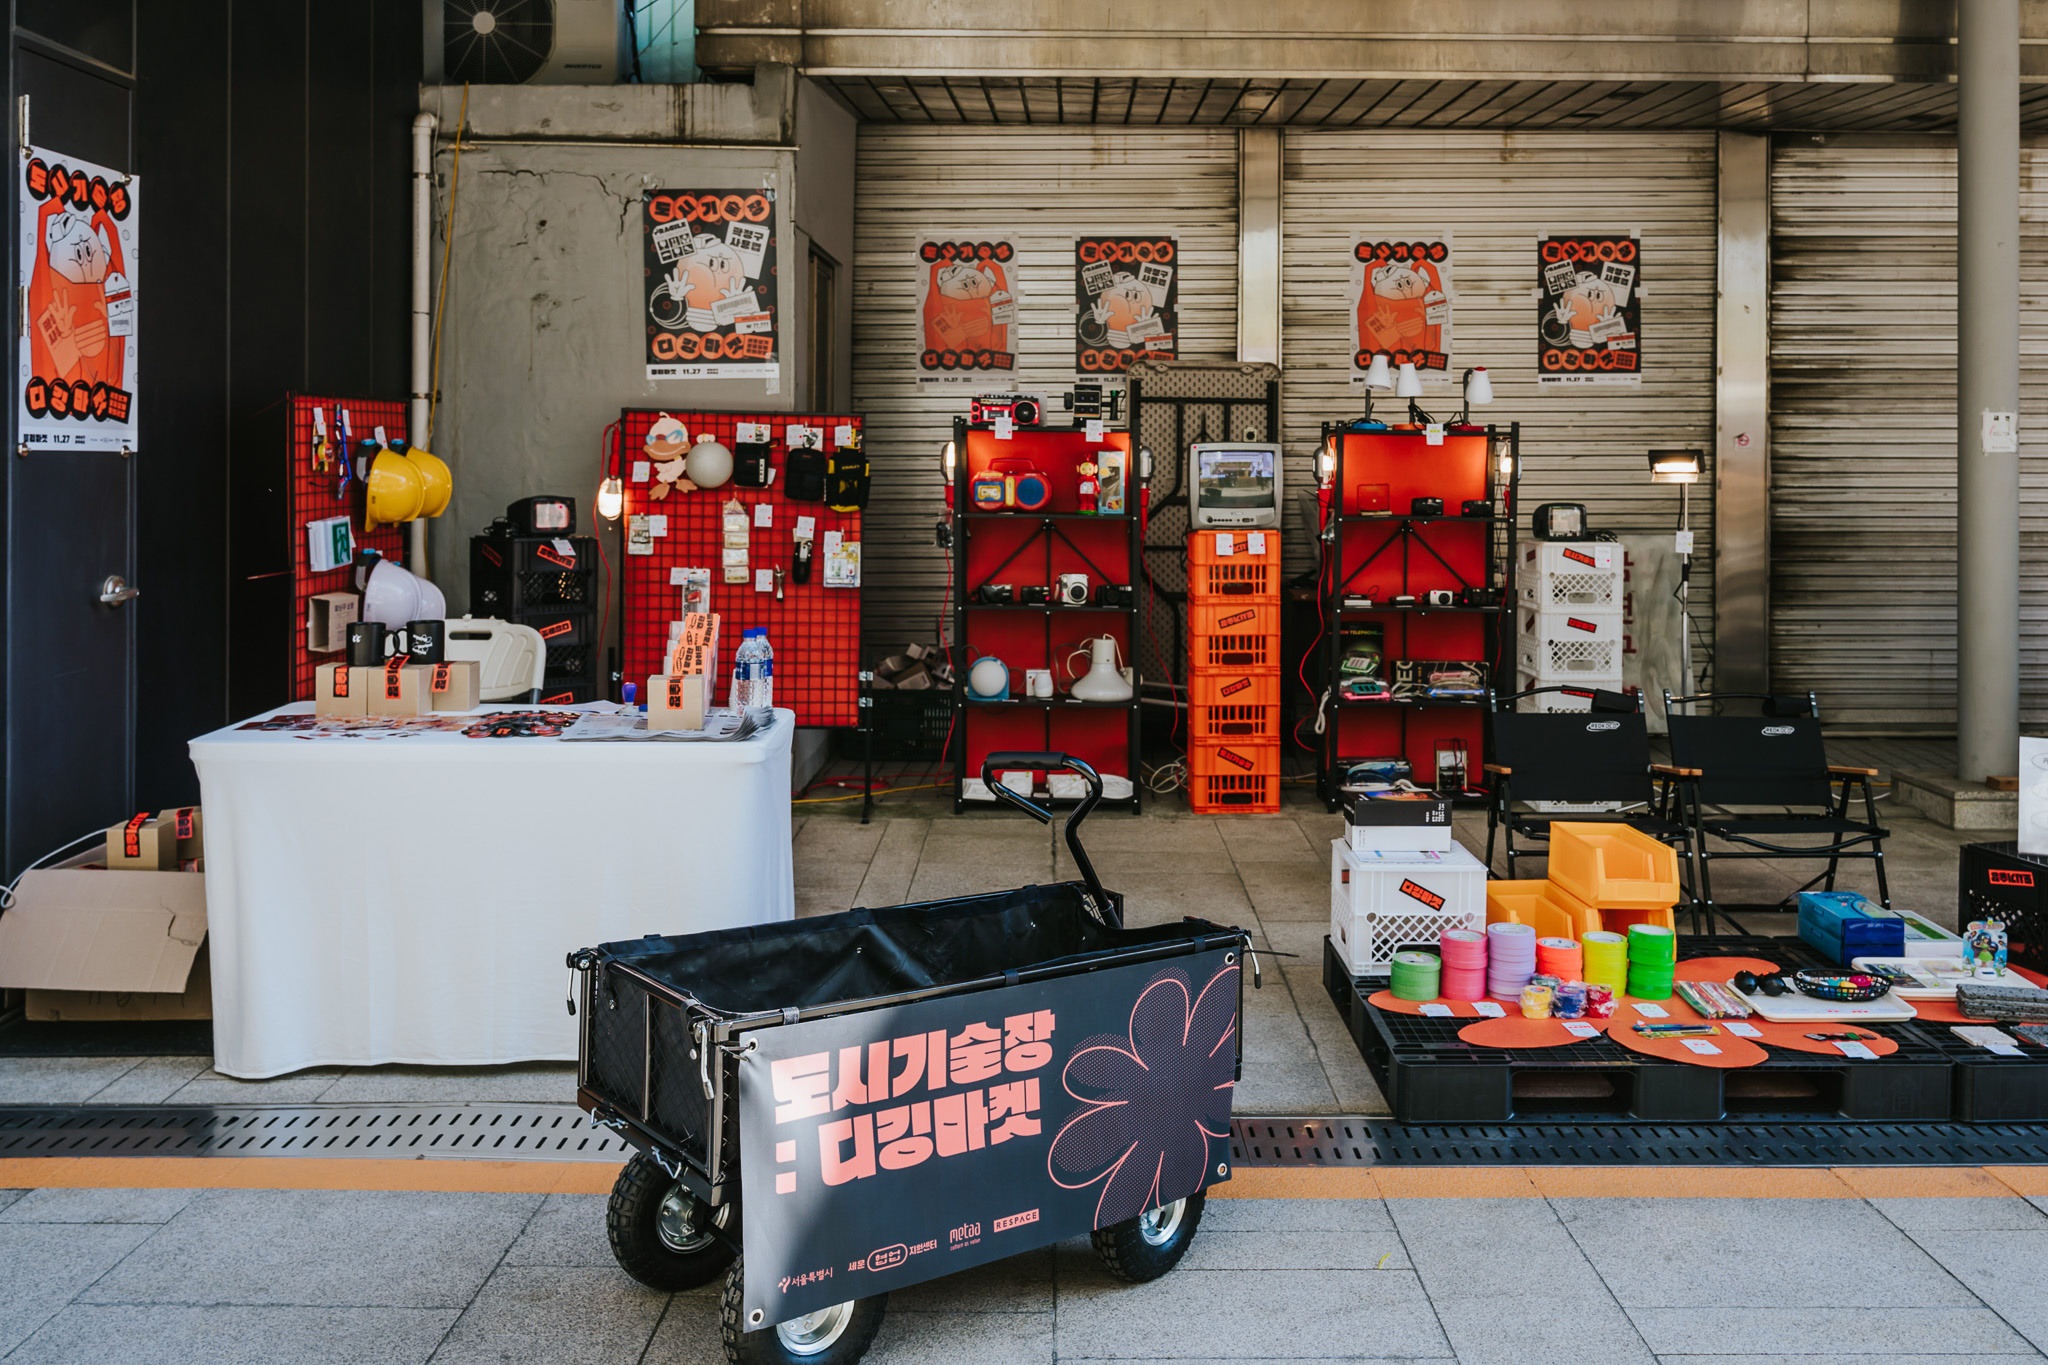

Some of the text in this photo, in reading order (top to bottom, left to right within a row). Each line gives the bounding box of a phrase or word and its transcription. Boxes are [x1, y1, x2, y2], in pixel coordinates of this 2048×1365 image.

[654, 199, 765, 218] 도시기술장
[53, 435, 70, 444] 11.27
[1401, 879, 1445, 910] 디깅마켓
[771, 1009, 1056, 1125] 도시기술장
[818, 1077, 1042, 1187] 디깅마켓
[996, 1211, 1038, 1230] RESPACE
[950, 1221, 981, 1244] metaa
[848, 1239, 938, 1272] 세운 협업 지원센터
[791, 1267, 833, 1287] 서울특별시
